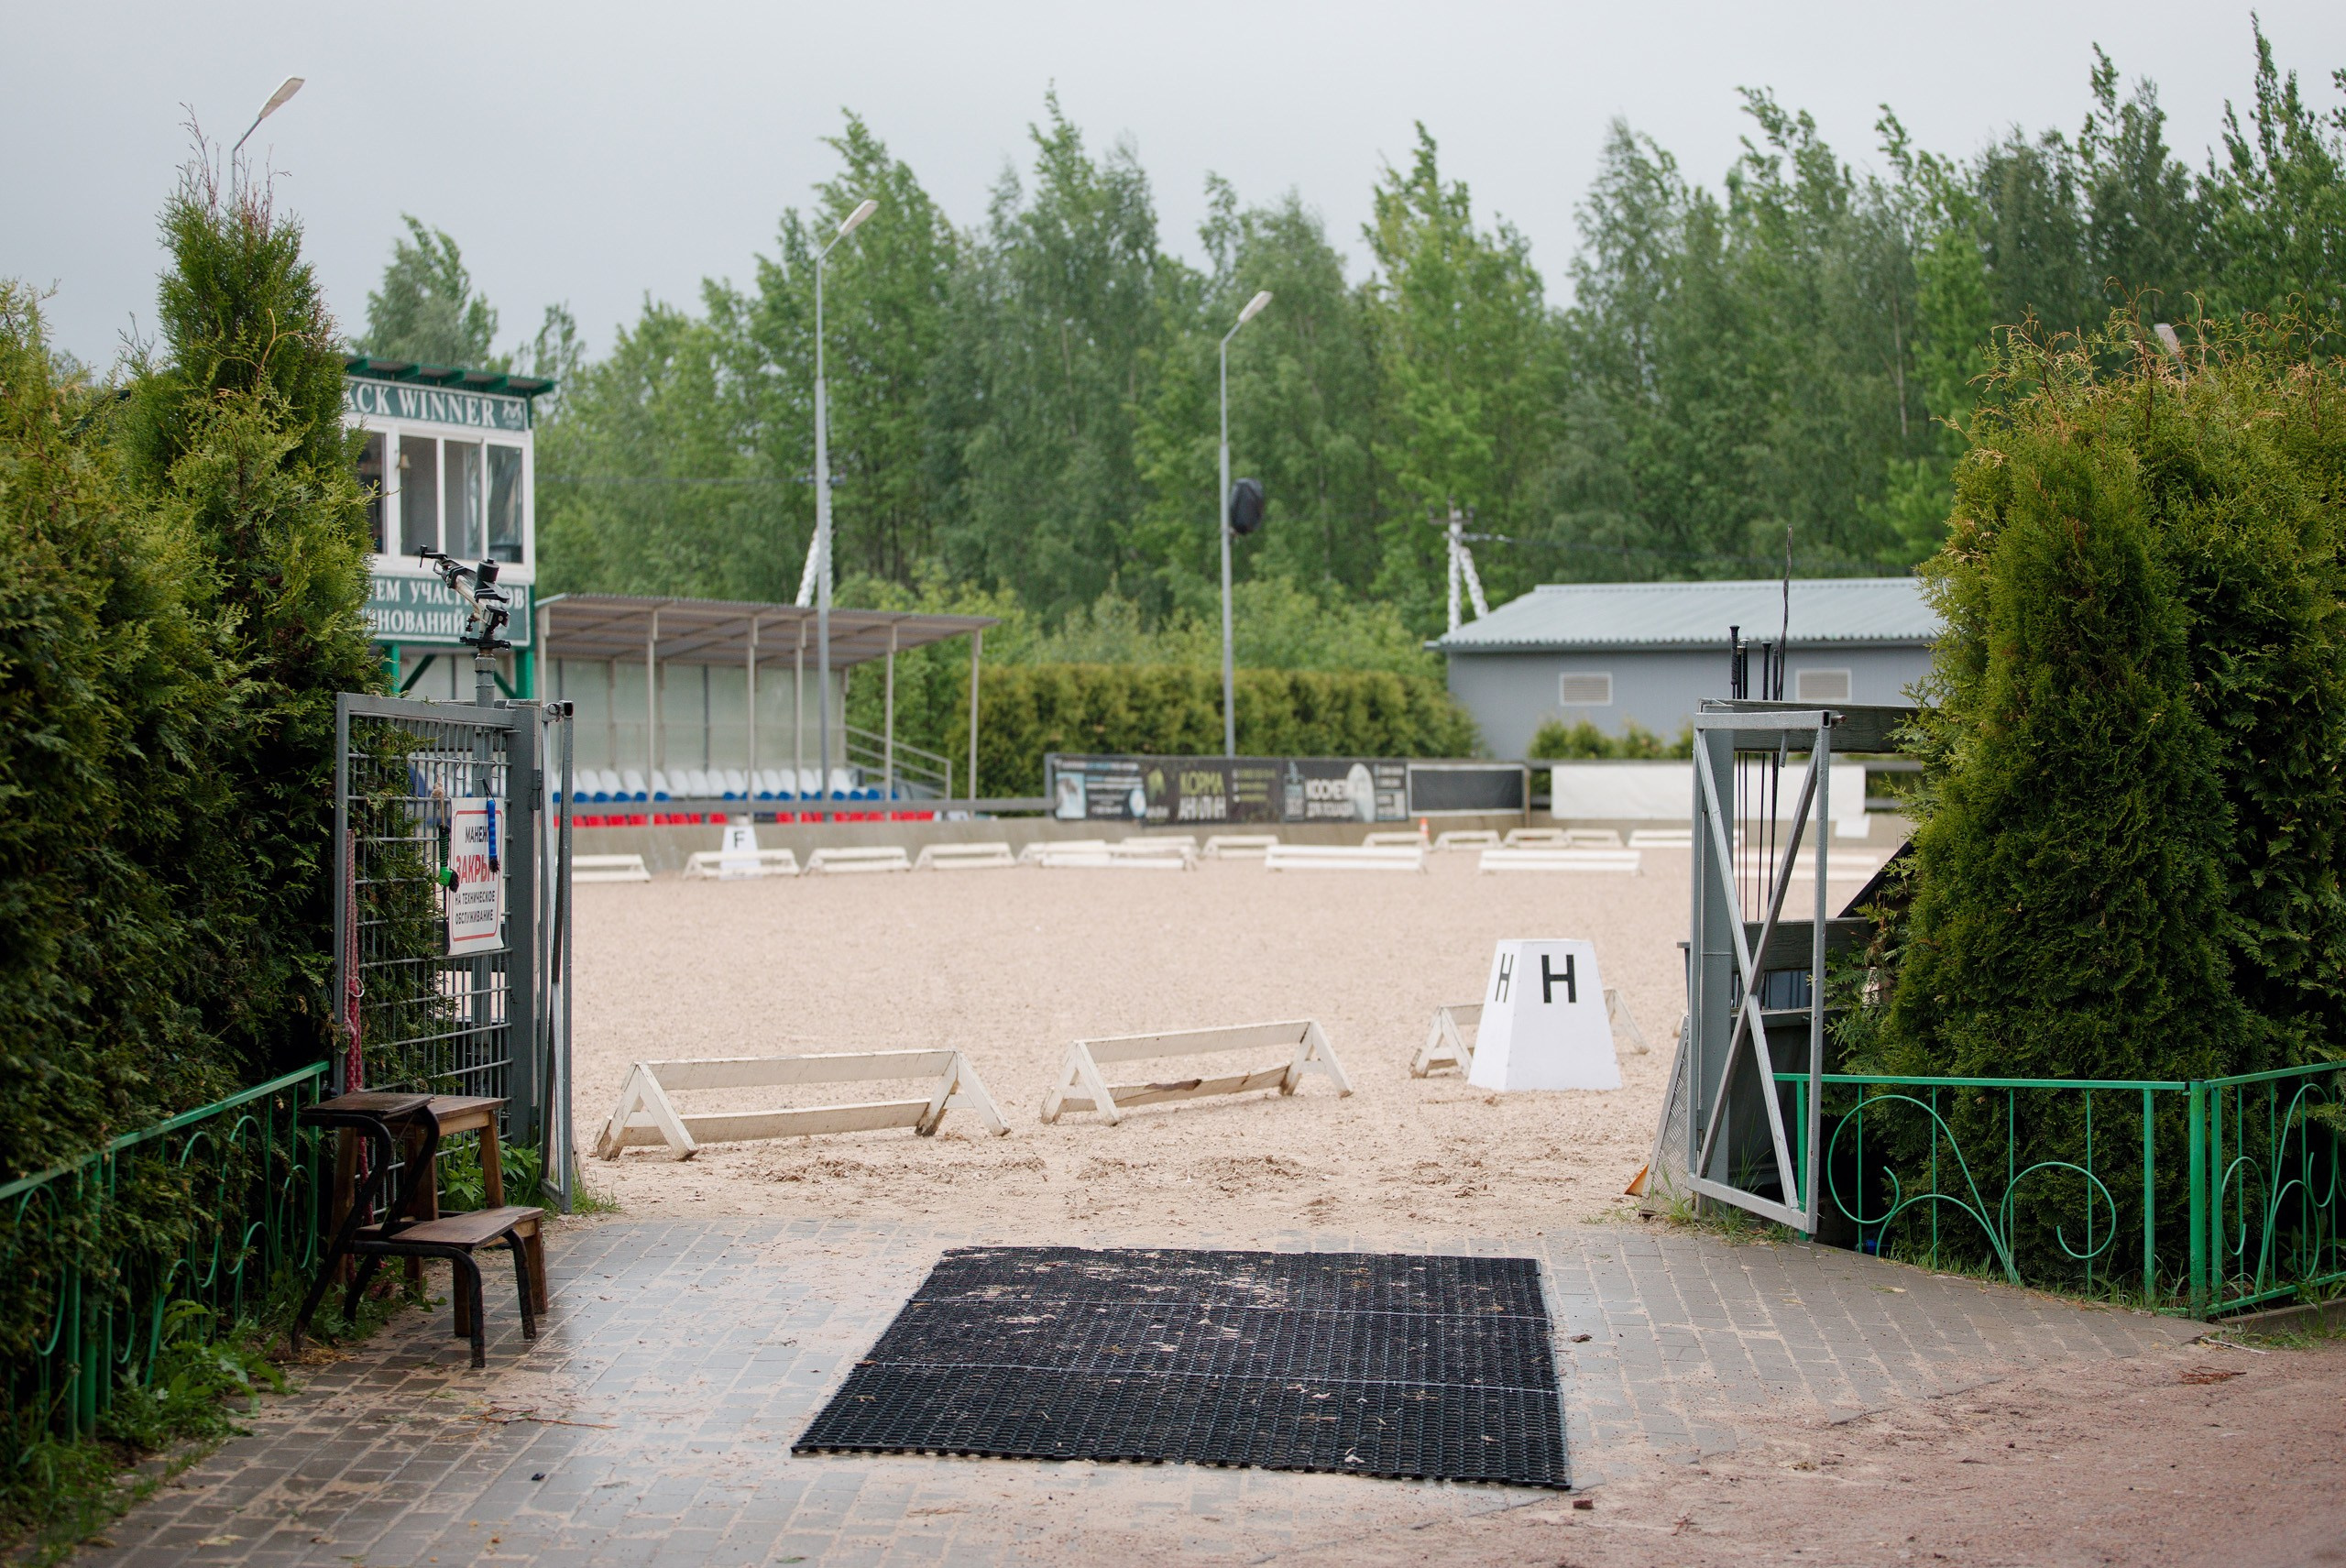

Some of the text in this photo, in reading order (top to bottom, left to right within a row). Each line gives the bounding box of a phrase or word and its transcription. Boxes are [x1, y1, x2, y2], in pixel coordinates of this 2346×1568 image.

[342, 382, 498, 428] ACK WINNER
[367, 578, 401, 602] ЕМ
[466, 826, 488, 843] МАНЕЖ
[734, 830, 746, 849] F
[455, 890, 496, 905] НА ТЕХНИЧЕСКОЕ
[455, 909, 494, 926] ОБСЛУЖИВАНИЕ
[1495, 953, 1514, 1003] H
[1541, 954, 1576, 1003] H
